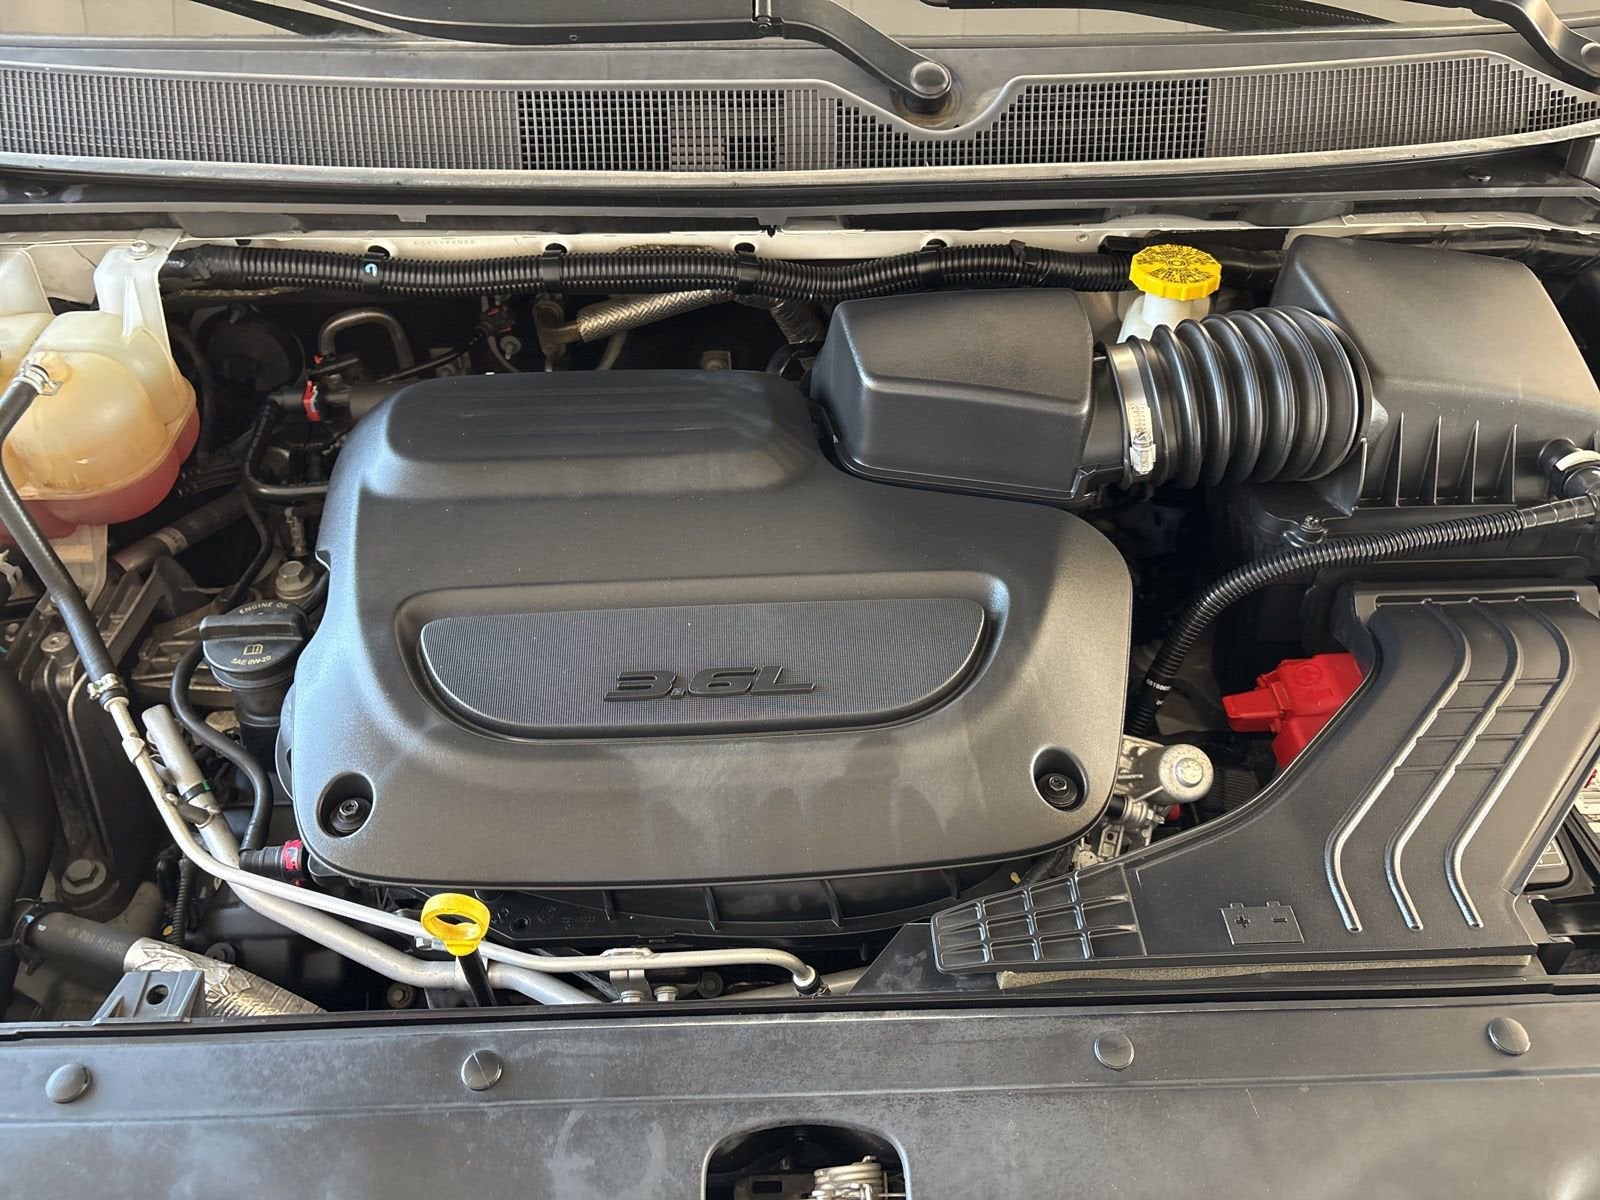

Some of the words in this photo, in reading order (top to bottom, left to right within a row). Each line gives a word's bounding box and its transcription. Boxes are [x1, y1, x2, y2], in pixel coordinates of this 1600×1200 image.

[239, 601, 273, 614] ENGINE
[230, 657, 247, 665] SAE
[603, 664, 817, 702] 3.6L
